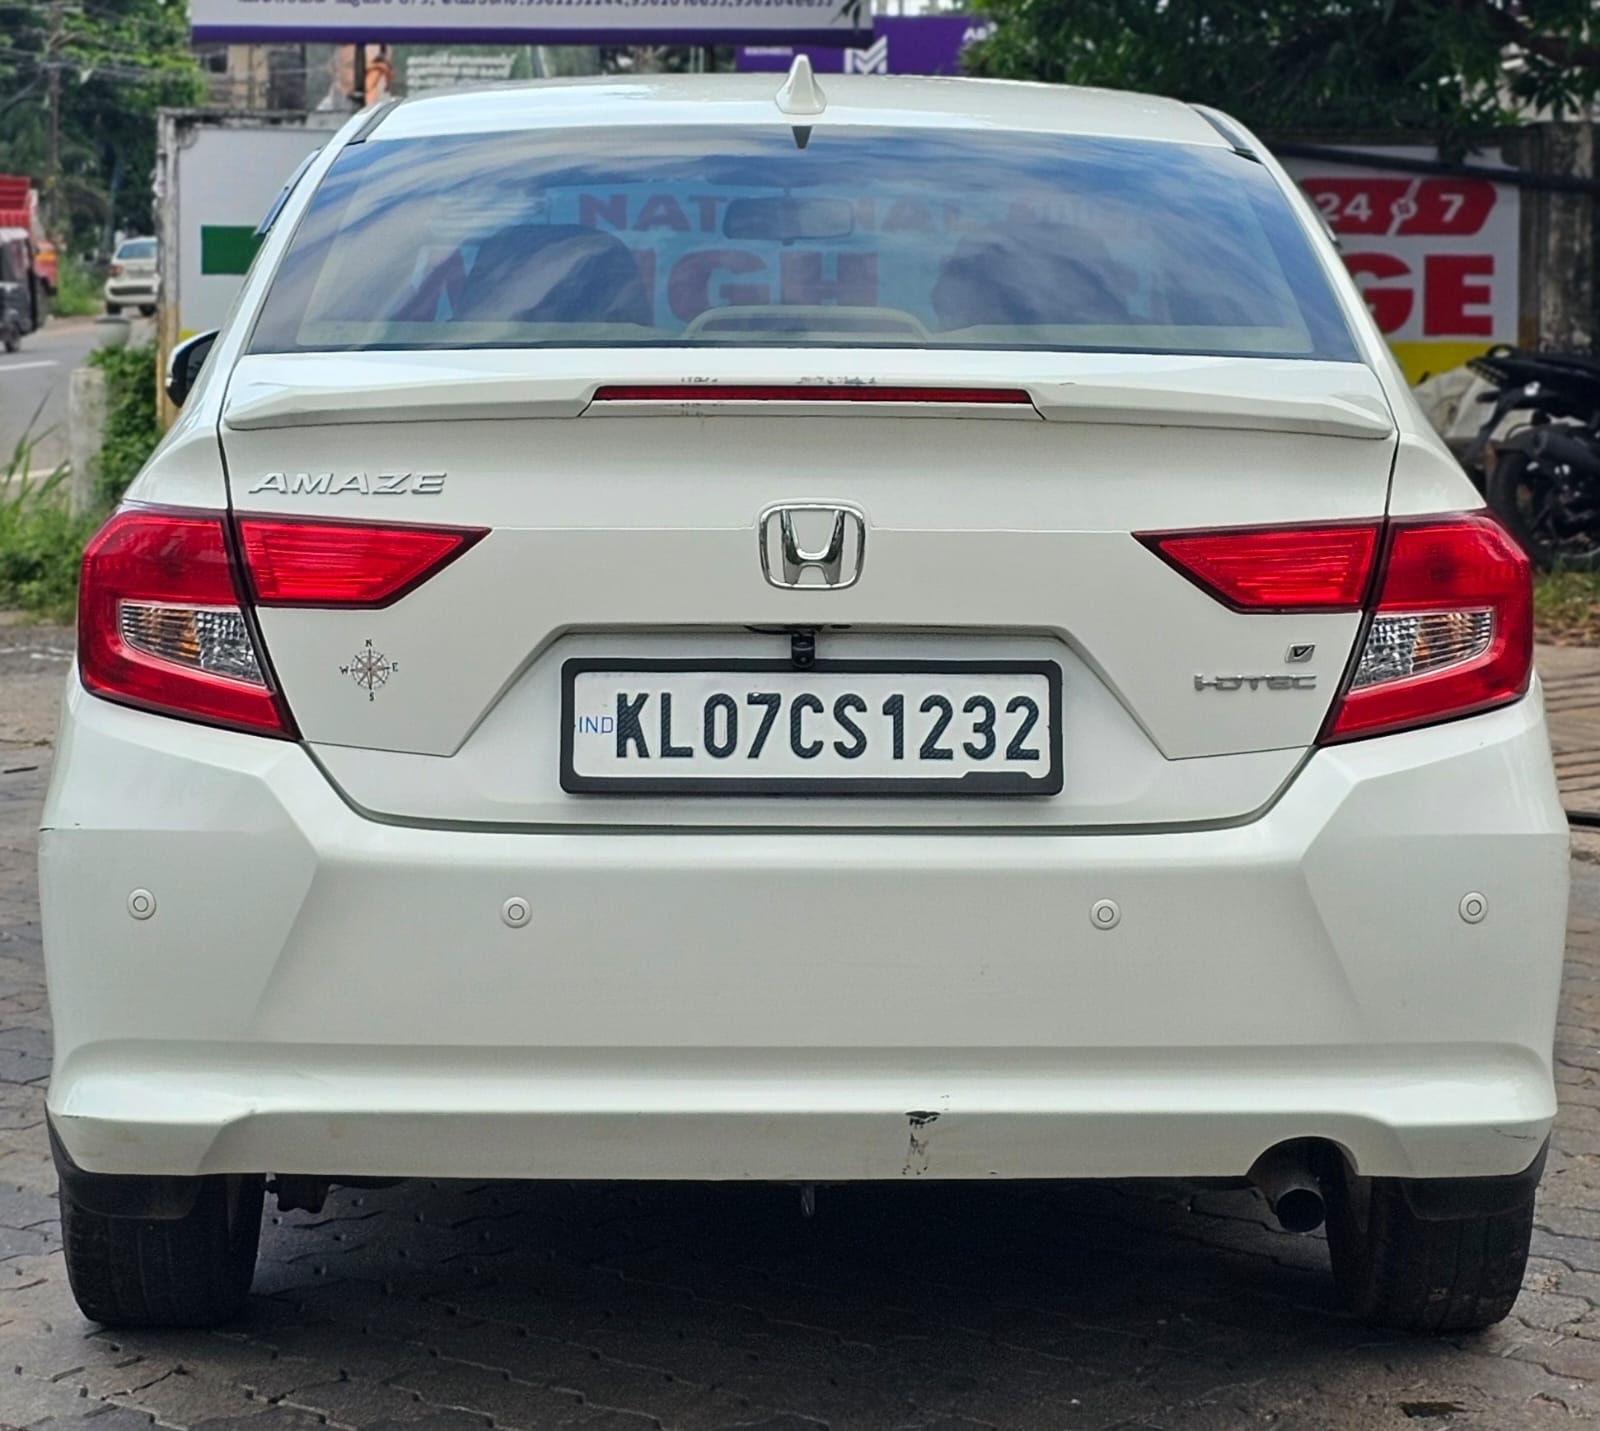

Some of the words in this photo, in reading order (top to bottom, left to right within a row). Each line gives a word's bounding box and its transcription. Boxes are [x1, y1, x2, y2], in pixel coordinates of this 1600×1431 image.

[249, 472, 447, 495] AMAZE
[578, 716, 614, 734] IND
[615, 692, 1040, 760] KL07CS1232
